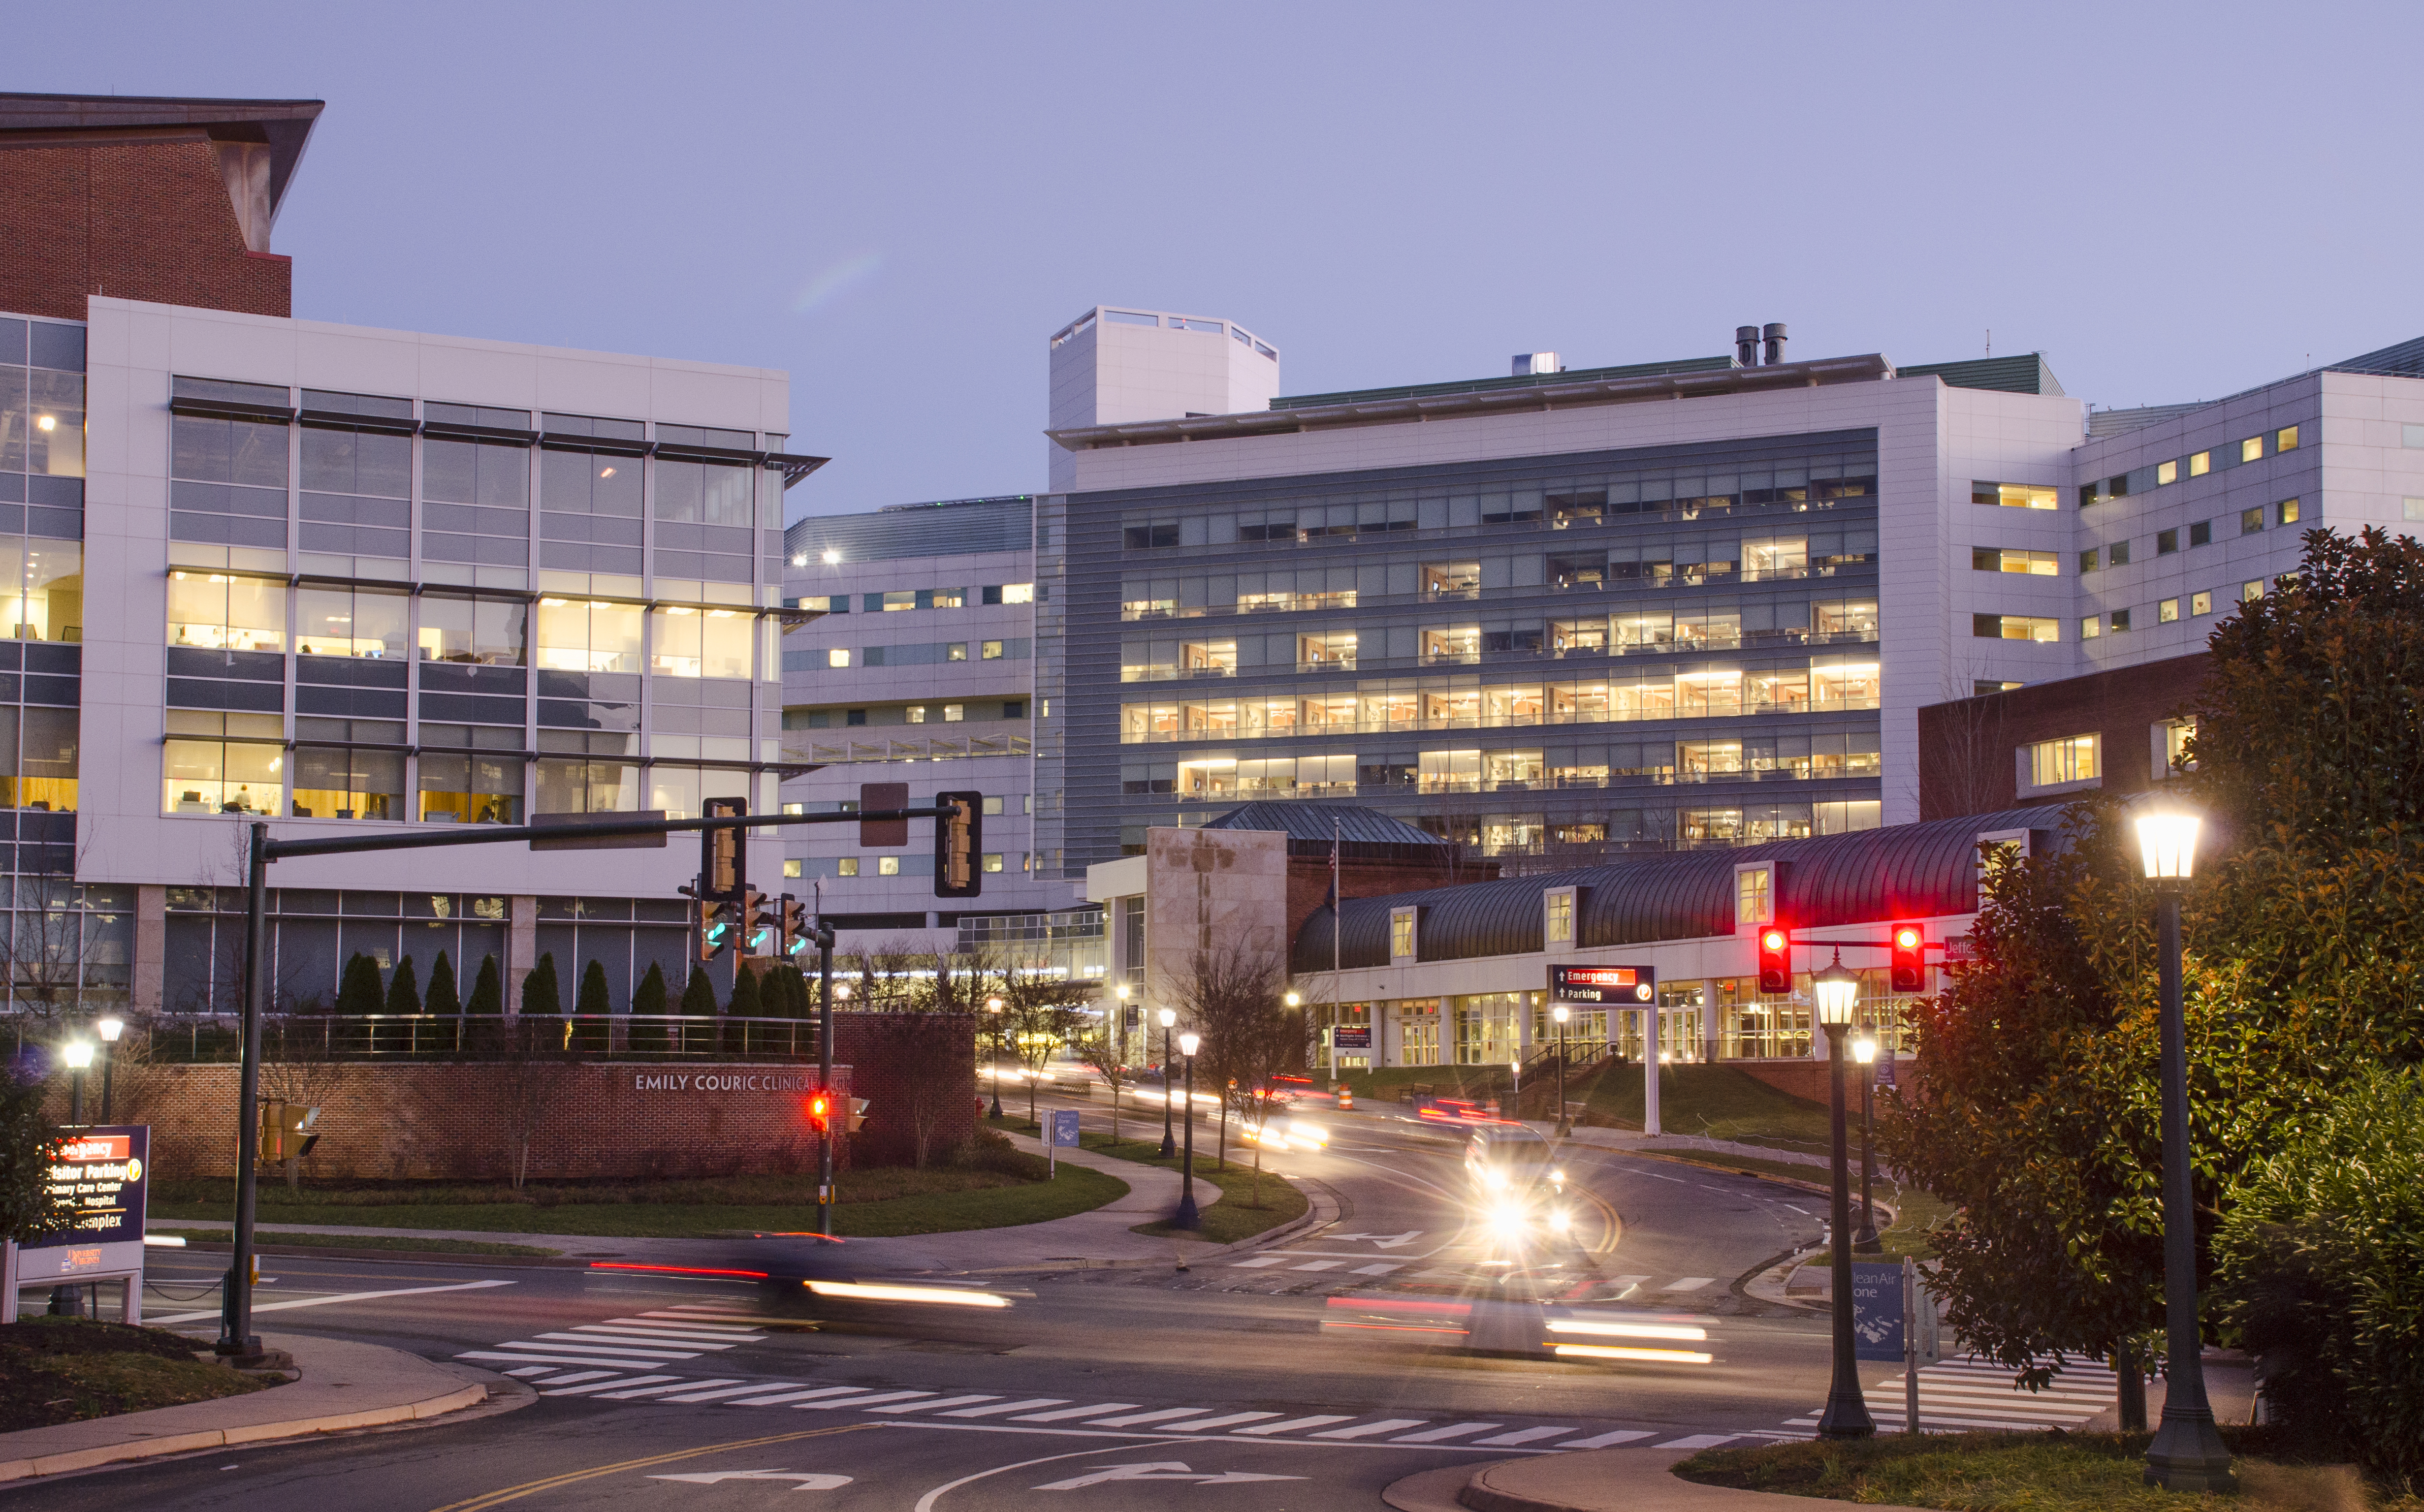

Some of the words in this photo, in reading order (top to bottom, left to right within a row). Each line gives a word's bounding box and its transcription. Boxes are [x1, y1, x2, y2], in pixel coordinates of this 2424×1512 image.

[1568, 971, 1619, 983] Emergency
[1568, 989, 1601, 1001] Parking
[636, 1075, 688, 1090] EMILY
[695, 1075, 756, 1090] COURIC
[762, 1075, 815, 1090] CLINICAL
[49, 1165, 83, 1180] isitor
[86, 1163, 127, 1180] Parking
[76, 1183, 95, 1194] Care
[96, 1182, 122, 1192] Center
[84, 1195, 116, 1208] Hospital
[75, 1214, 122, 1231] omplex
[1853, 1272, 1878, 1284] lean
[1879, 1273, 1897, 1285] Air
[1853, 1288, 1878, 1297] one
